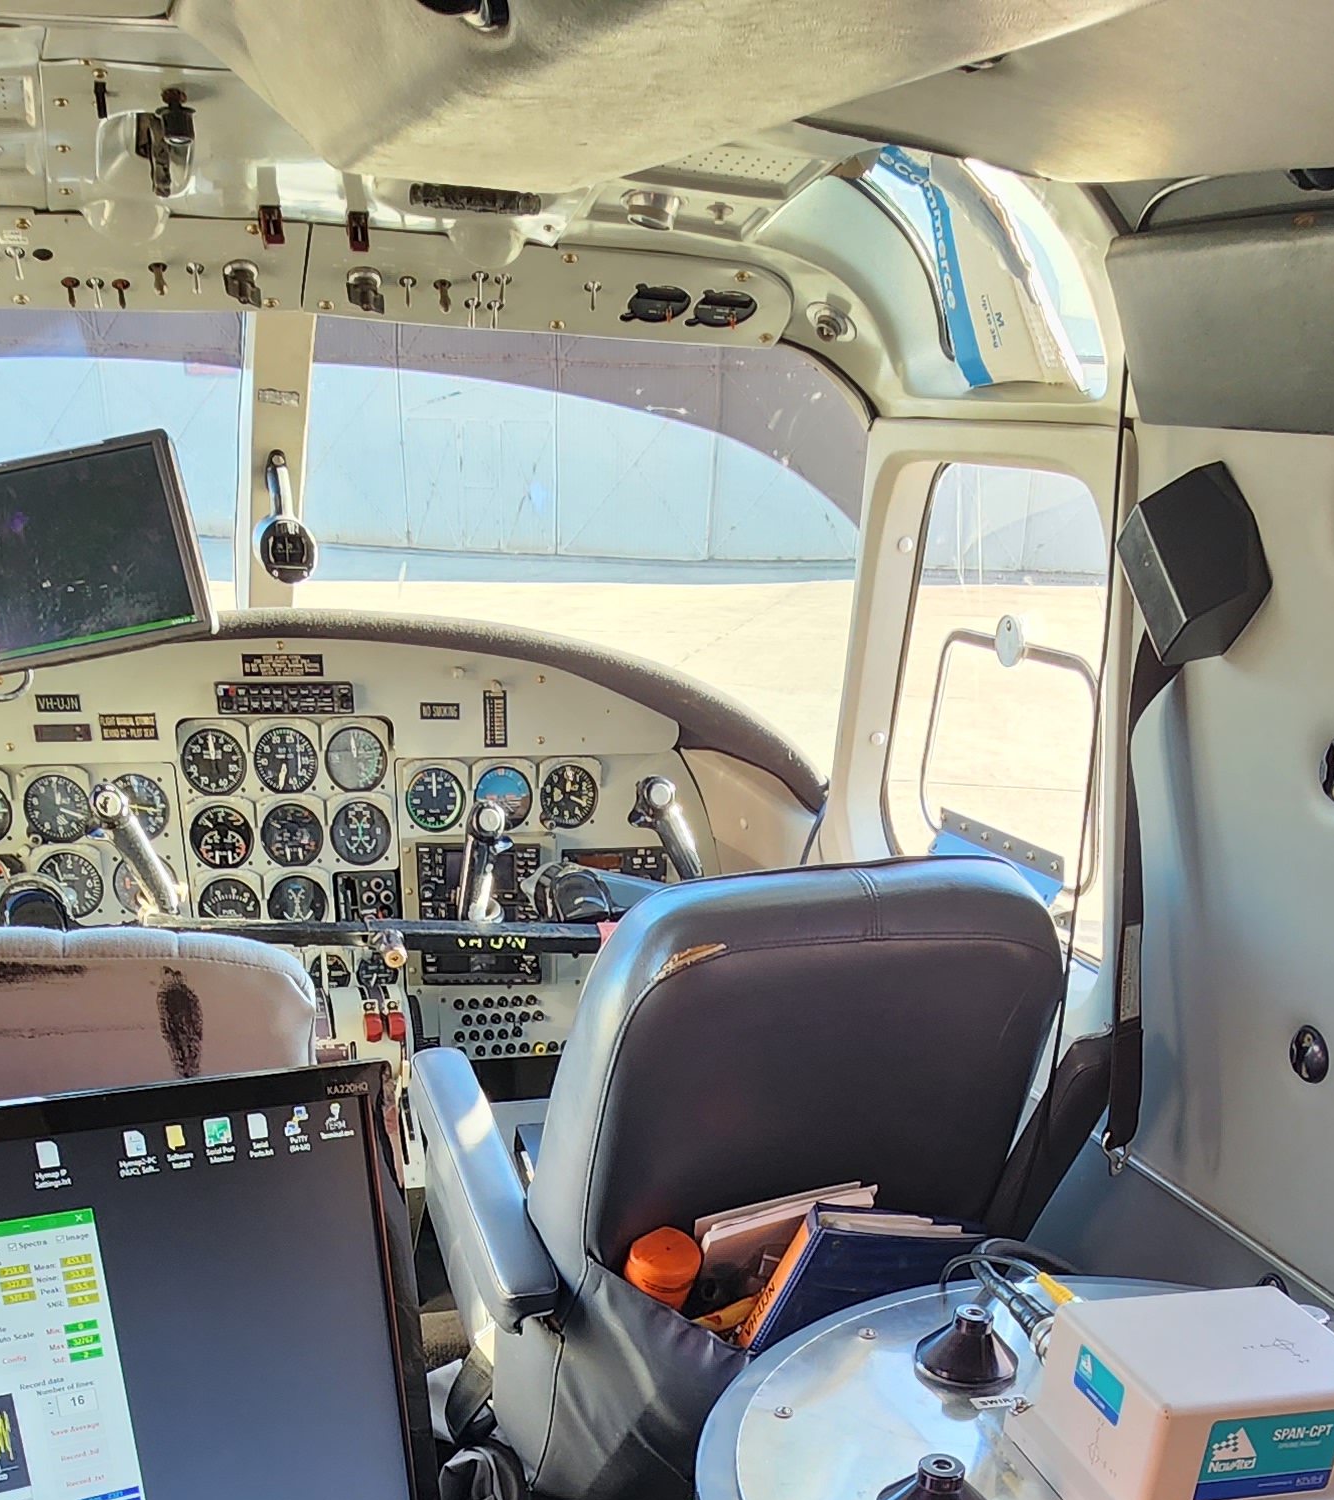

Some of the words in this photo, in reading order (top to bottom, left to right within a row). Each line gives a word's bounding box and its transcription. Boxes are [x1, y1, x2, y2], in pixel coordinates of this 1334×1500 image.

[995, 312, 1006, 328] M
[37, 697, 78, 710] VH-UJN
[422, 705, 431, 718] NO
[432, 705, 458, 718] SMOKING
[130, 728, 143, 738] PILOT
[327, 1082, 368, 1096] KA220HQ
[65, 1231, 89, 1244] Image
[18, 1239, 48, 1251] Spectra
[745, 1281, 774, 1337] VH-UJN
[14, 1331, 35, 1343] Scale
[20, 1379, 46, 1391] Record
[48, 1376, 64, 1386] data
[36, 1385, 66, 1397] Number
[67, 1383, 75, 1391] of
[71, 1395, 85, 1407] 16
[1273, 1424, 1334, 1441] SPAN-CPT
